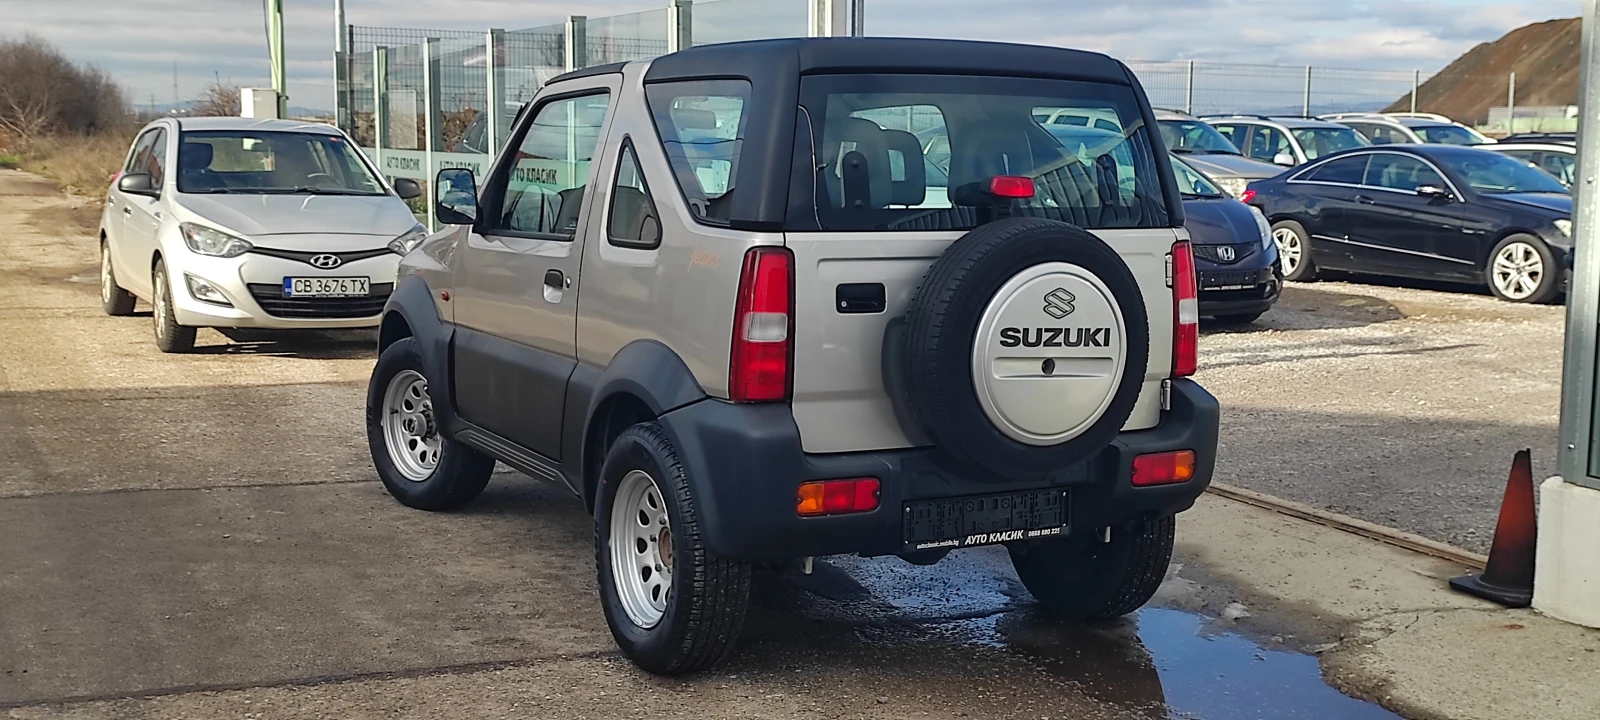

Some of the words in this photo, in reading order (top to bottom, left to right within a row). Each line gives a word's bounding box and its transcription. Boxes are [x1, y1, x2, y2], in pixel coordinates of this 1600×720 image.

[526, 167, 558, 185] КЛАСИК
[315, 279, 348, 293] 3676
[999, 327, 1111, 348] SUZUKI
[964, 533, 988, 546] АУТО
[989, 530, 1024, 542] КЛАСИК
